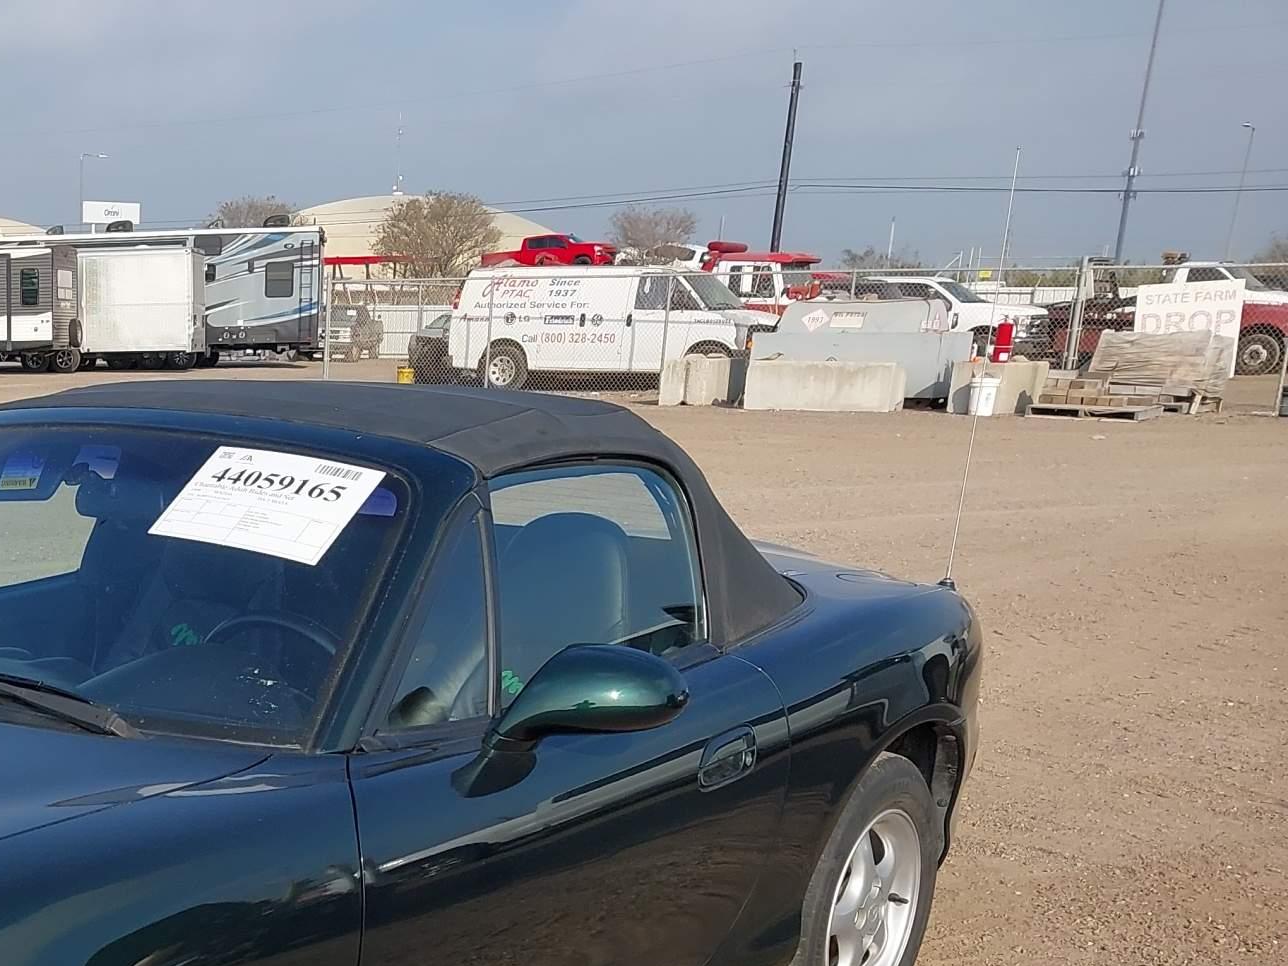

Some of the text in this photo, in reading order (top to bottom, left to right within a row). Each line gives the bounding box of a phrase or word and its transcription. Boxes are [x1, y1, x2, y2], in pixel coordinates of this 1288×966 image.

[482, 274, 581, 297] Alamo Since
[500, 289, 578, 298] PTAC 1937
[474, 301, 527, 309] Authorized
[529, 301, 567, 309] Service
[1145, 289, 1237, 305] STATE FARM
[1141, 310, 1236, 334] DROP
[521, 334, 538, 343] Call
[541, 331, 566, 344] (800)
[211, 467, 348, 502] 44059165
